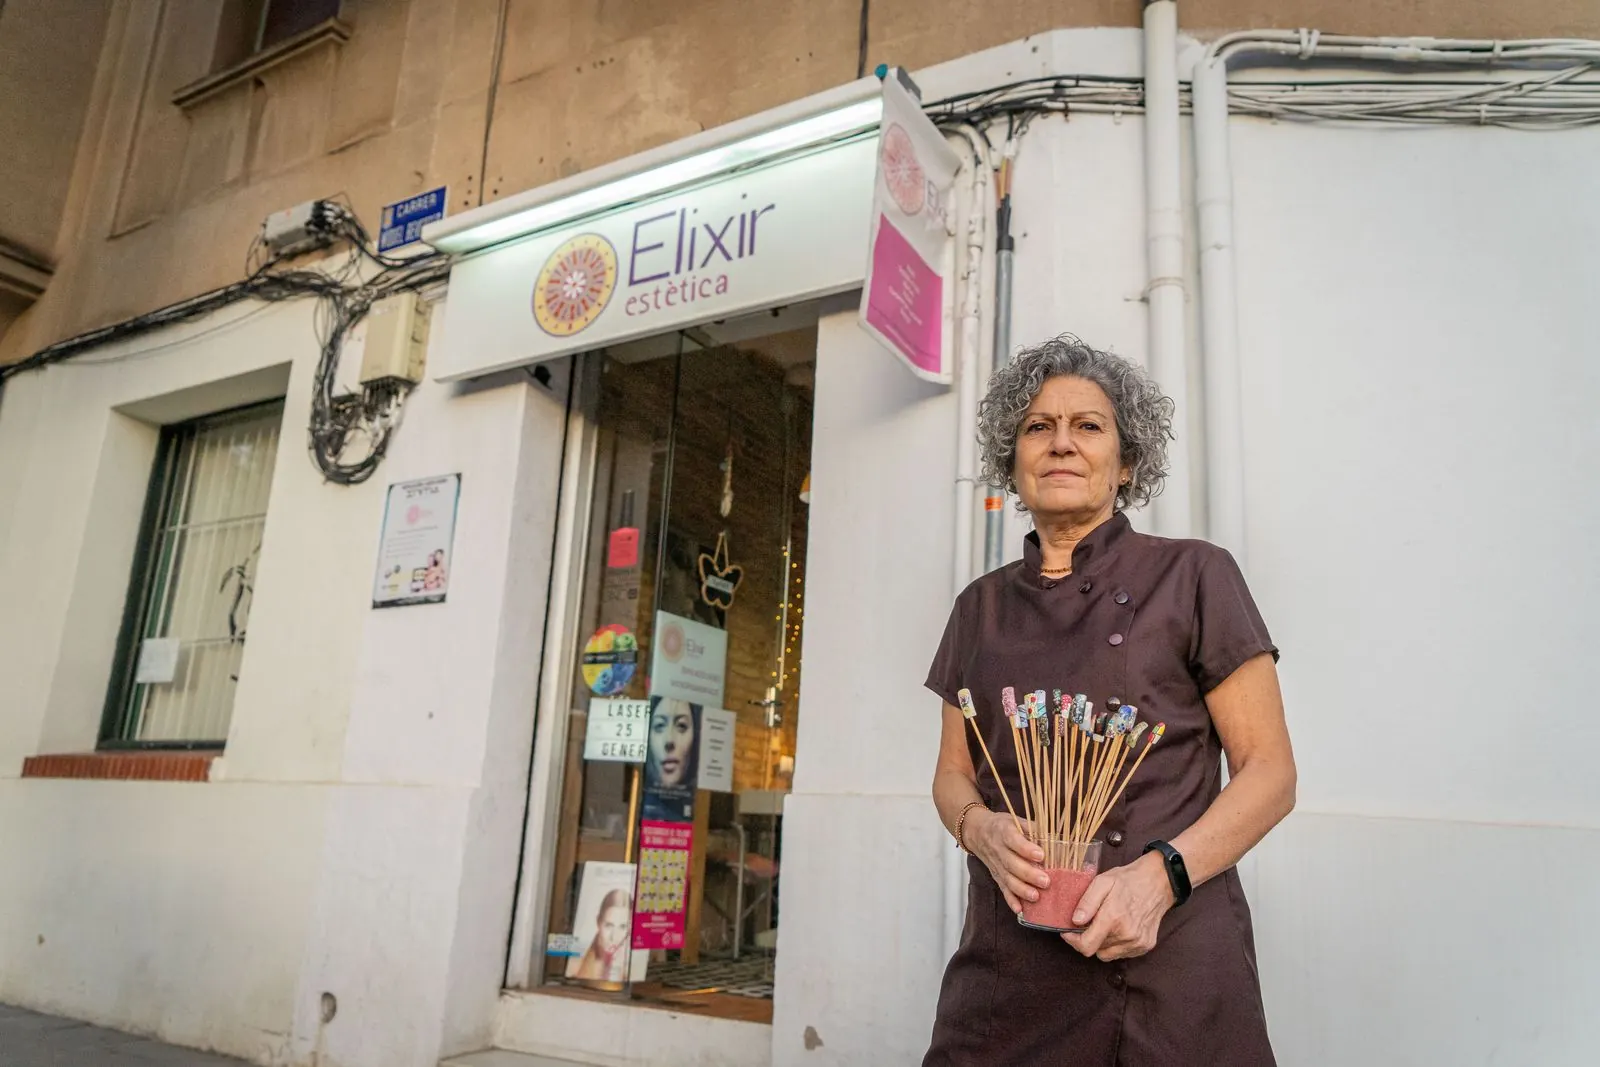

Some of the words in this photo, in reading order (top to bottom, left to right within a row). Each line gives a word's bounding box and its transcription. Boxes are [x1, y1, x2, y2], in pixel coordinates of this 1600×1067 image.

[396, 192, 437, 218] CARRER
[628, 193, 776, 287] Elixir
[625, 274, 728, 316] estètica
[616, 723, 633, 737] 25
